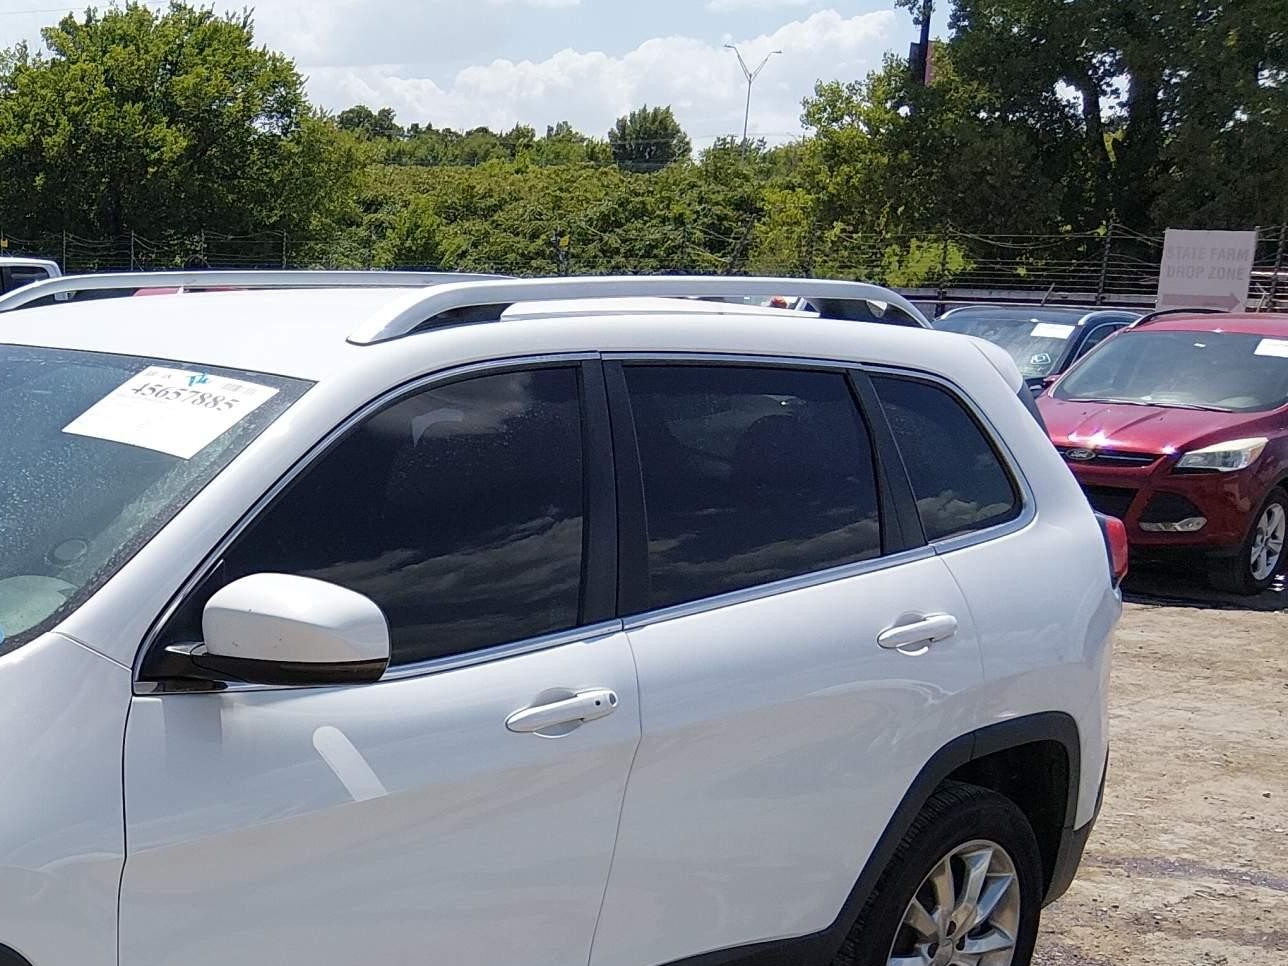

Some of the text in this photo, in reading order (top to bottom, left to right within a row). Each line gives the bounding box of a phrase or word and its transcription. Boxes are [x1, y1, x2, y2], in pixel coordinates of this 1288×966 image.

[1166, 246, 1249, 262] STATE FARM
[1166, 265, 1245, 281] DROP ZONE
[131, 382, 240, 411] 45657885
